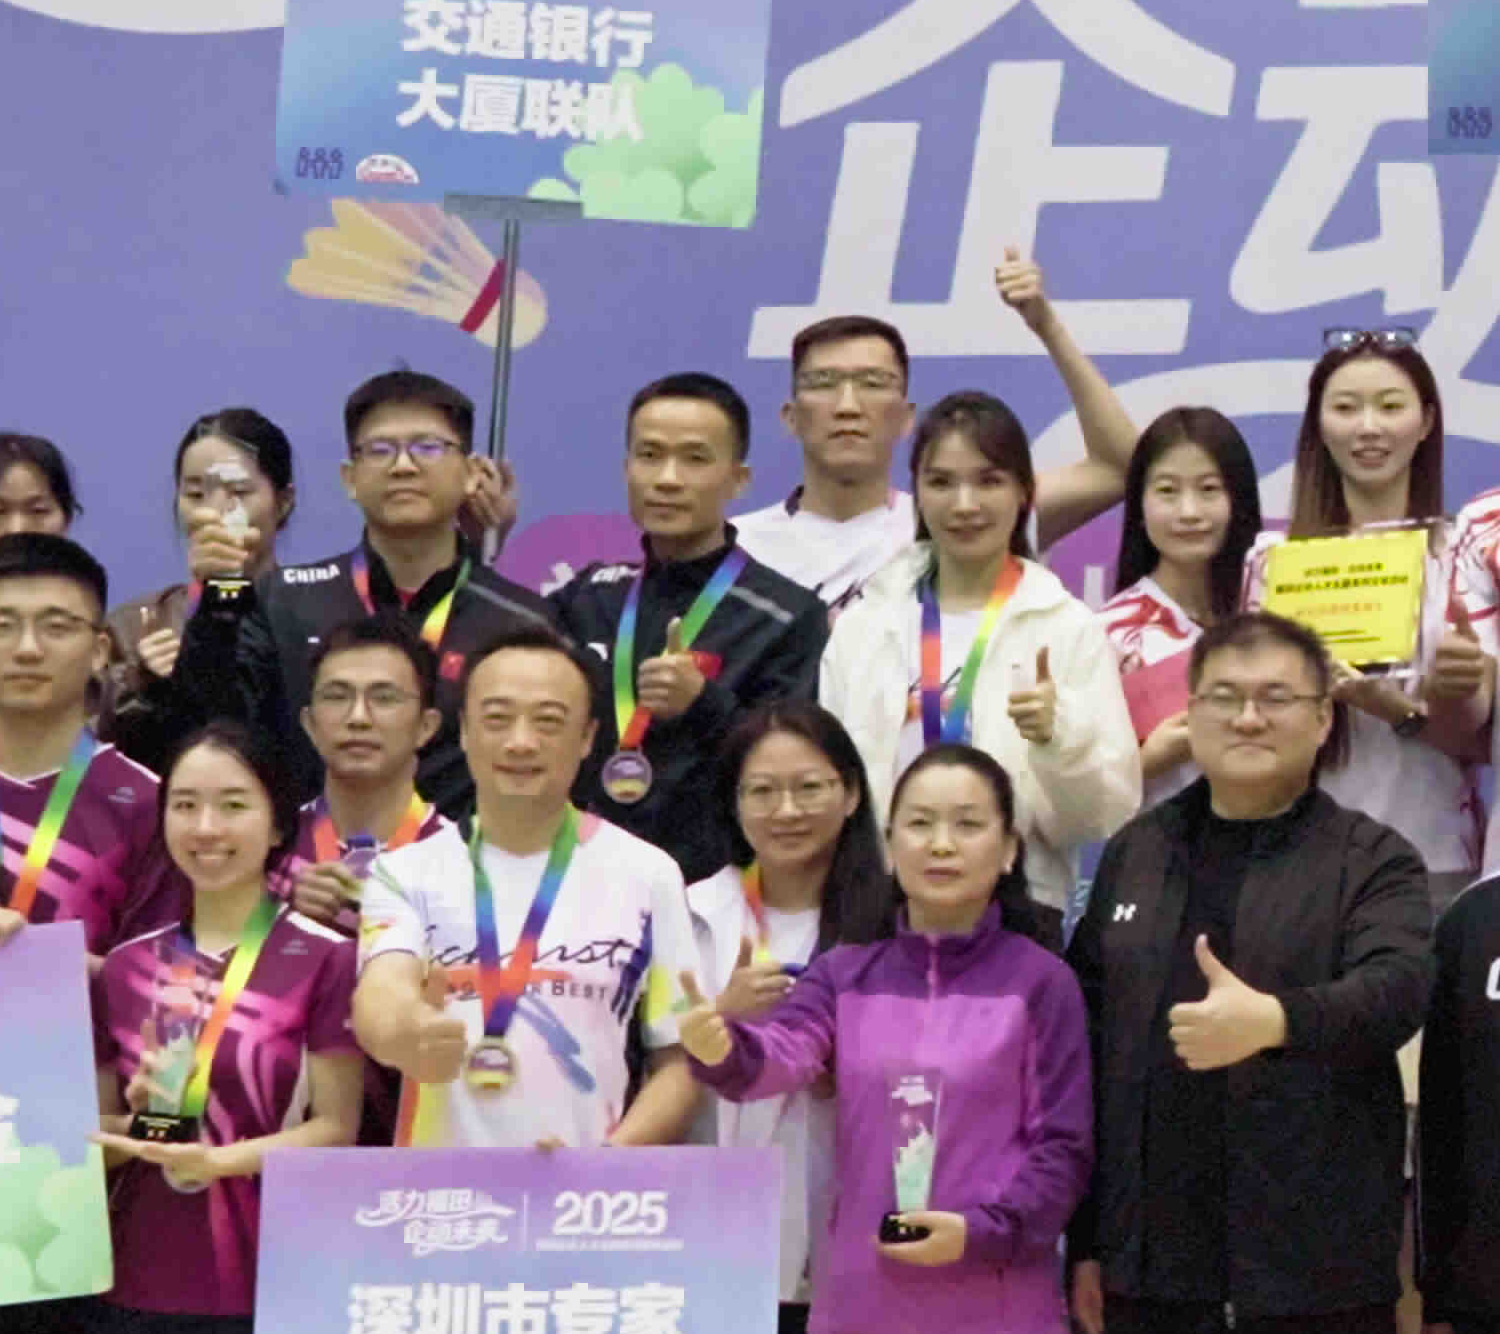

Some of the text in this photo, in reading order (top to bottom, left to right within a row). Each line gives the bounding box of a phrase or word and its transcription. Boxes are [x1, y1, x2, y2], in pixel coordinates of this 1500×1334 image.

[395, 68, 645, 141] 大厦联队
[283, 564, 340, 584] CHINA
[552, 1189, 670, 1238] 2025
